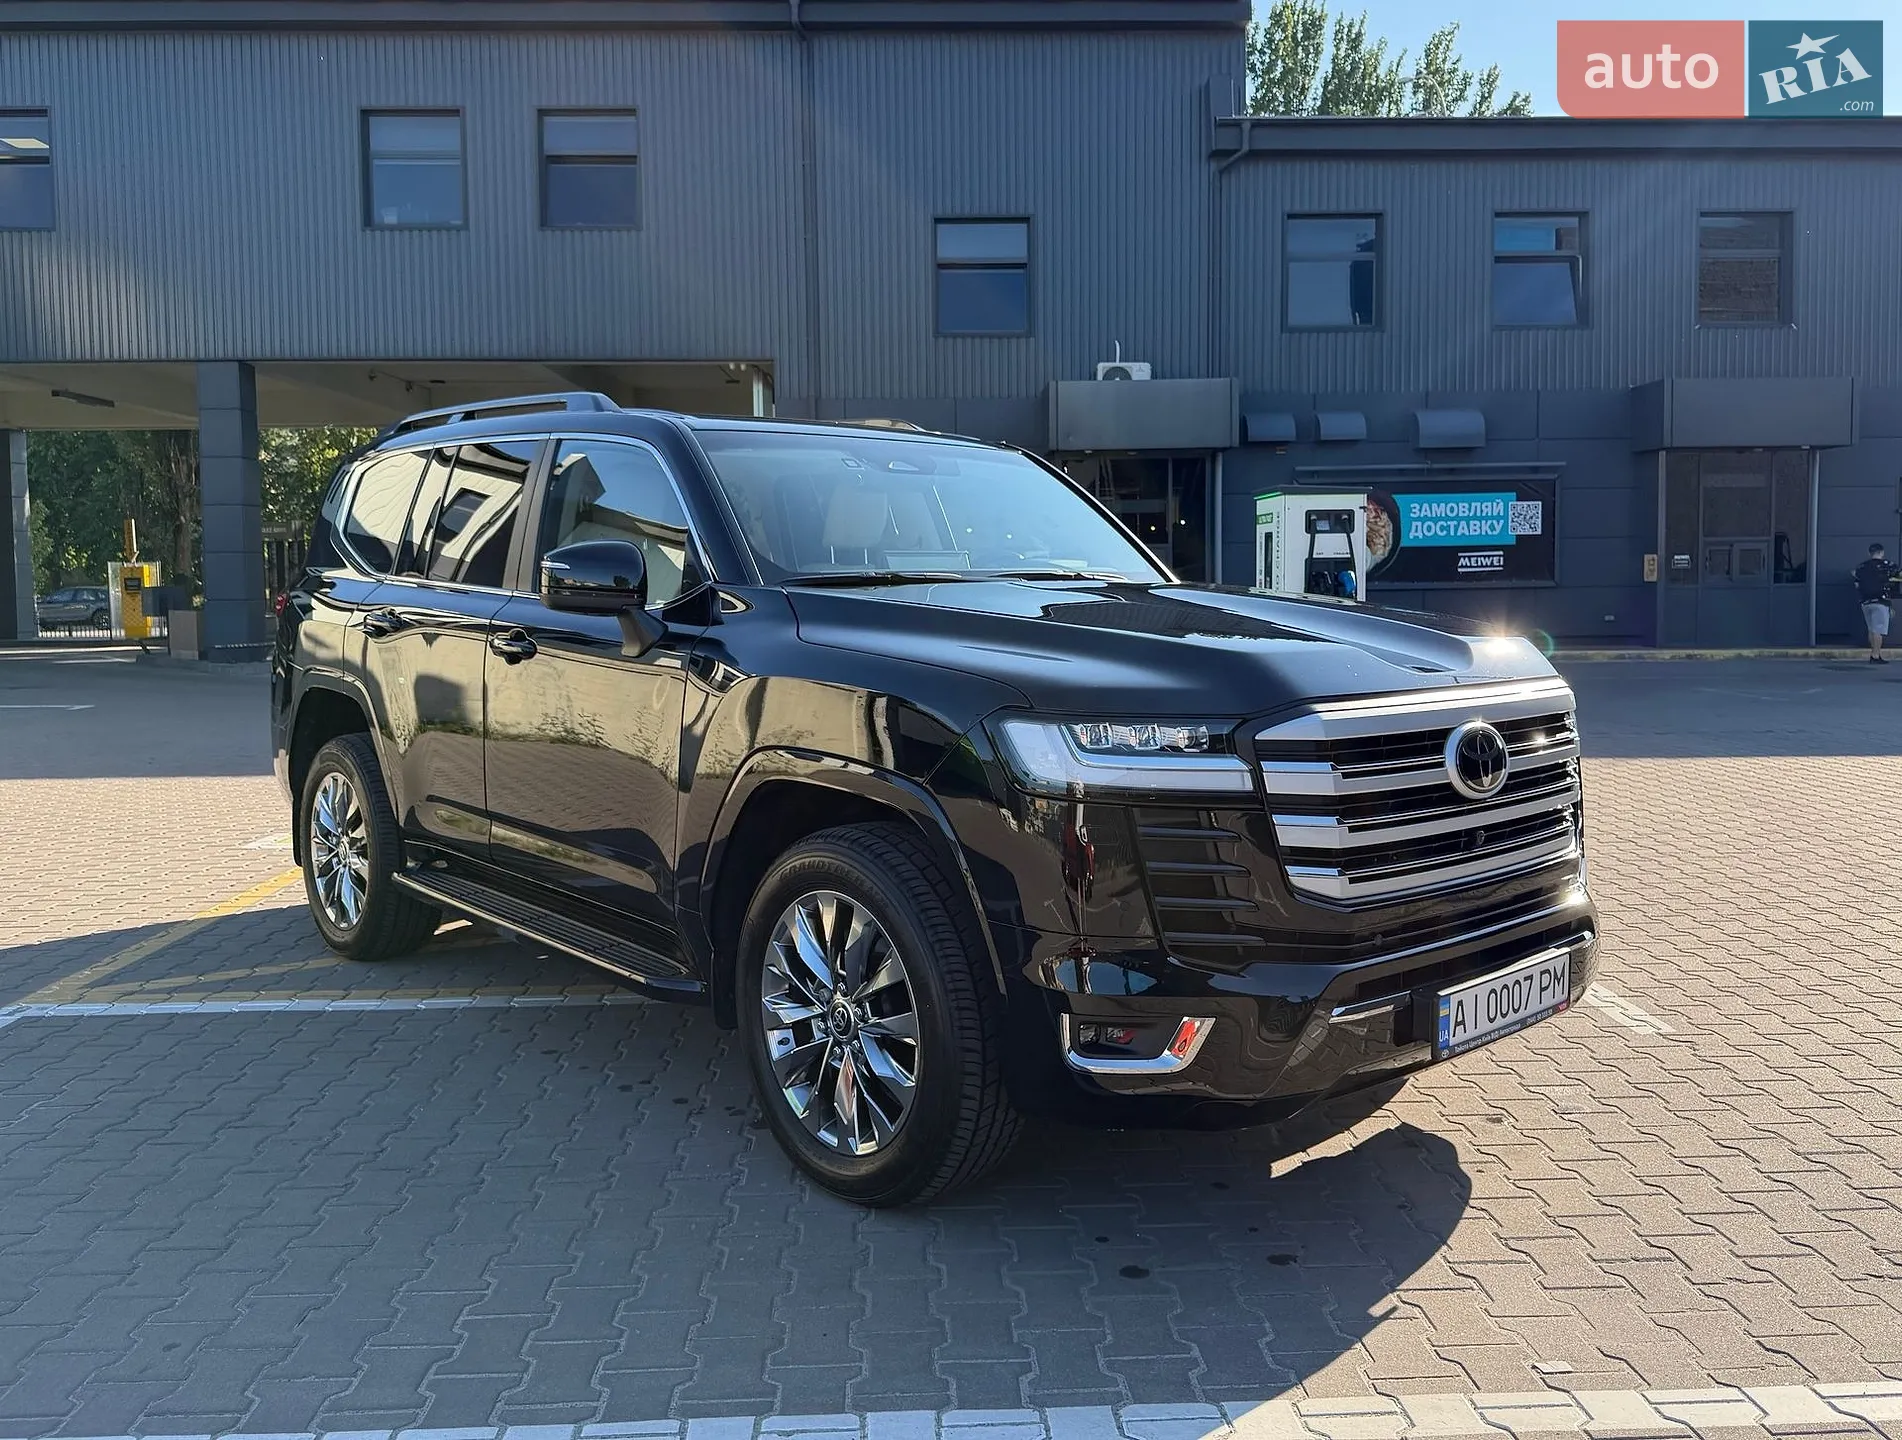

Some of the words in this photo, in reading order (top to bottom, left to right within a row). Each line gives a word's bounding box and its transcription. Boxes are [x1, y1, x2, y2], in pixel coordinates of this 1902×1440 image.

[1410, 499, 1504, 518] ЗАМОВЛЯЙ
[1409, 519, 1505, 539] ДОСТАВКУ
[1458, 556, 1504, 567] MEIWEI
[1487, 973, 1534, 1024] 0007
[1539, 962, 1566, 1005] PM
[1439, 1030, 1449, 1043] UA
